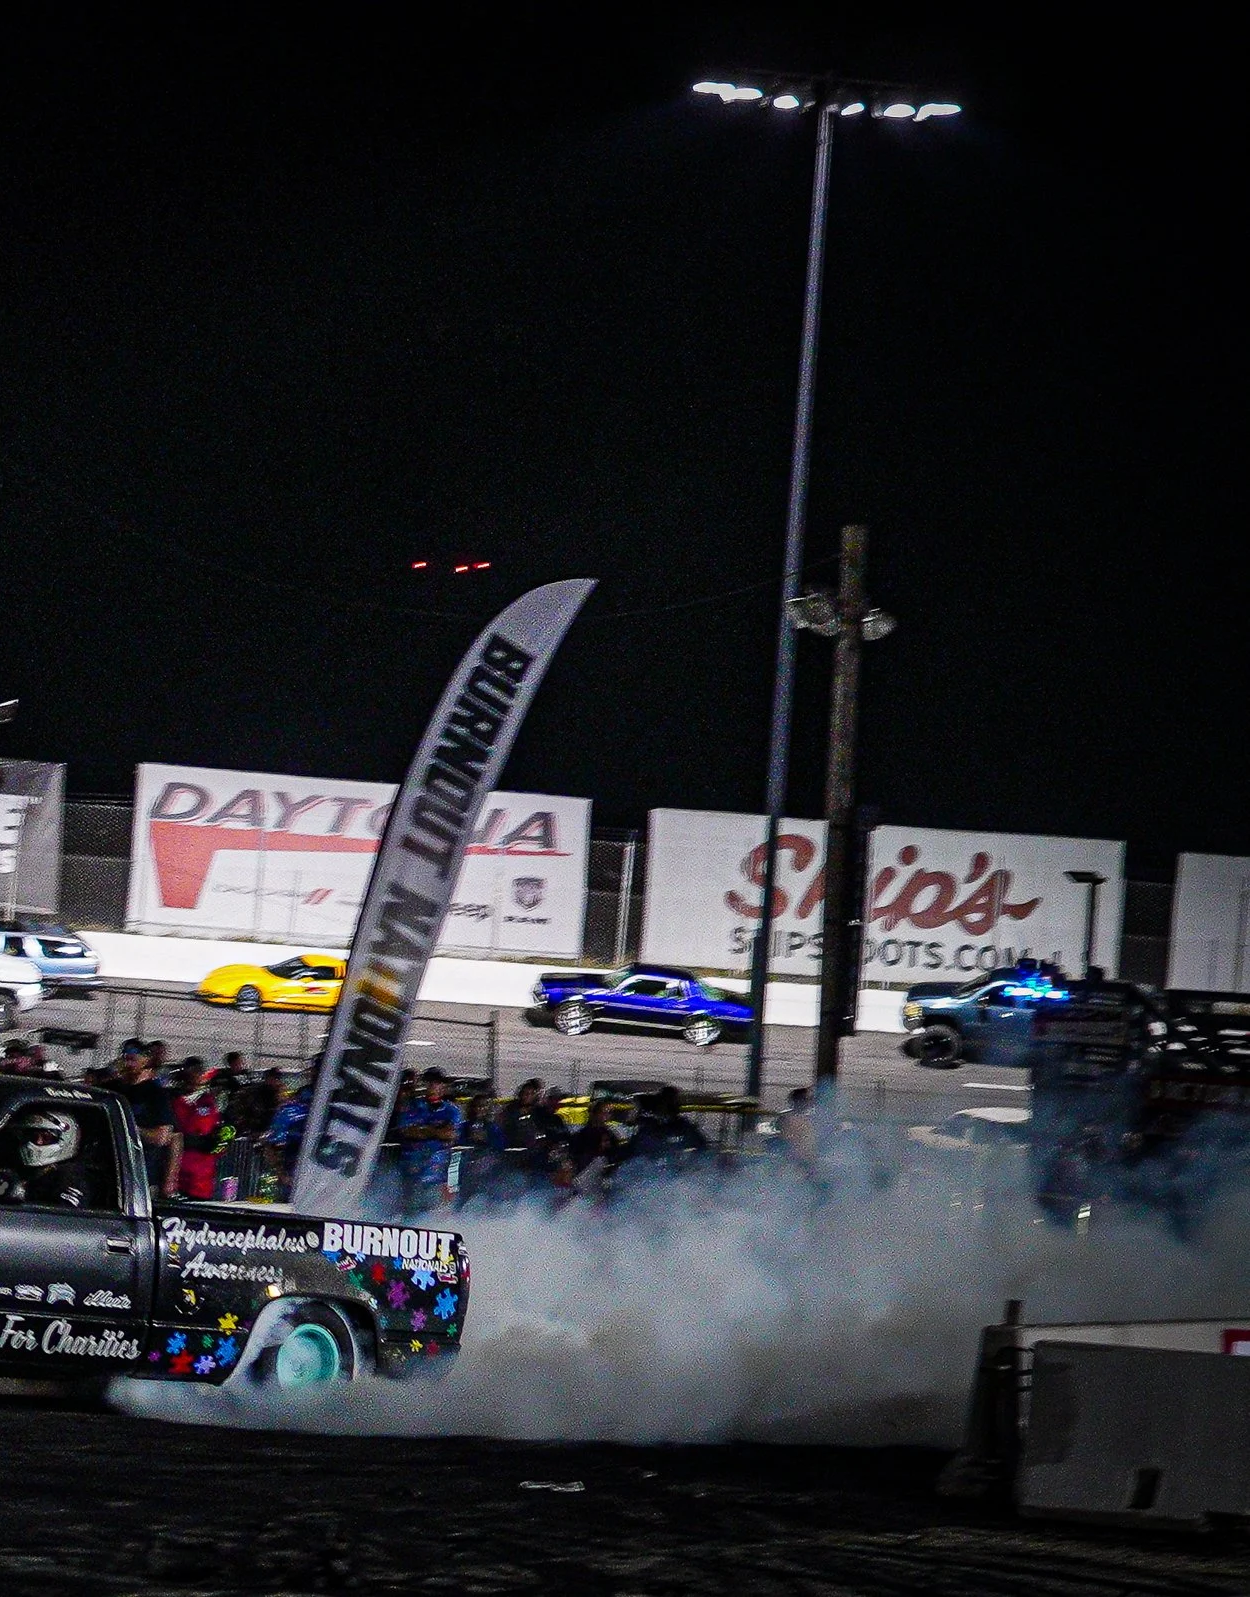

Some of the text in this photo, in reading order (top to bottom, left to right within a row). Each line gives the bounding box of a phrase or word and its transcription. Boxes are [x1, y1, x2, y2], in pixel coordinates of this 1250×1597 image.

[313, 634, 534, 1177] BURNOUT NATIONALS
[161, 1216, 307, 1256] Hydrocephalus
[323, 1221, 455, 1261] BURNOUT
[402, 1258, 451, 1274] NATIONALS
[40, 1318, 142, 1361] Charities
